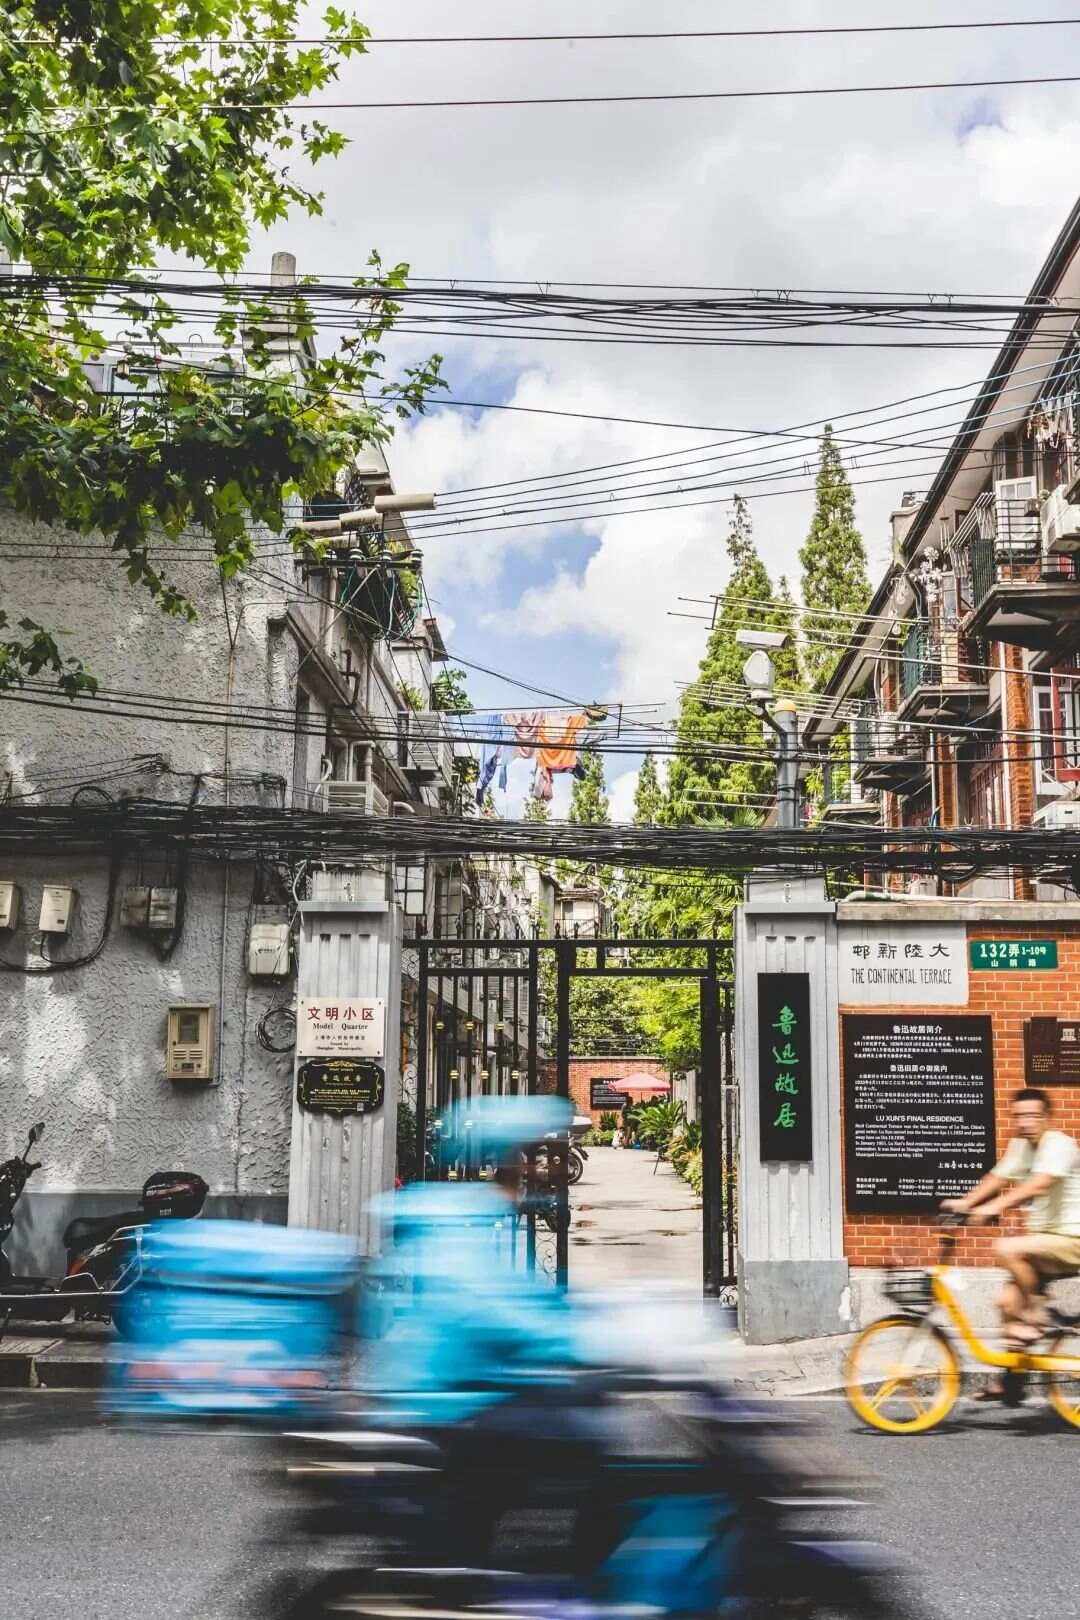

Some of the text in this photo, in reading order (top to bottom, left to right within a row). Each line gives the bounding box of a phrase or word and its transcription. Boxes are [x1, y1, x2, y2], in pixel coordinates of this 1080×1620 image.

[851, 968, 952, 984] THE CONTINENTAL TERRACE
[307, 1006, 375, 1021] 文明小区
[341, 1023, 368, 1031] Quarter
[893, 1025, 943, 1034] 鲁迅故居简介
[772, 1005, 799, 1128] 鲁迅故居
